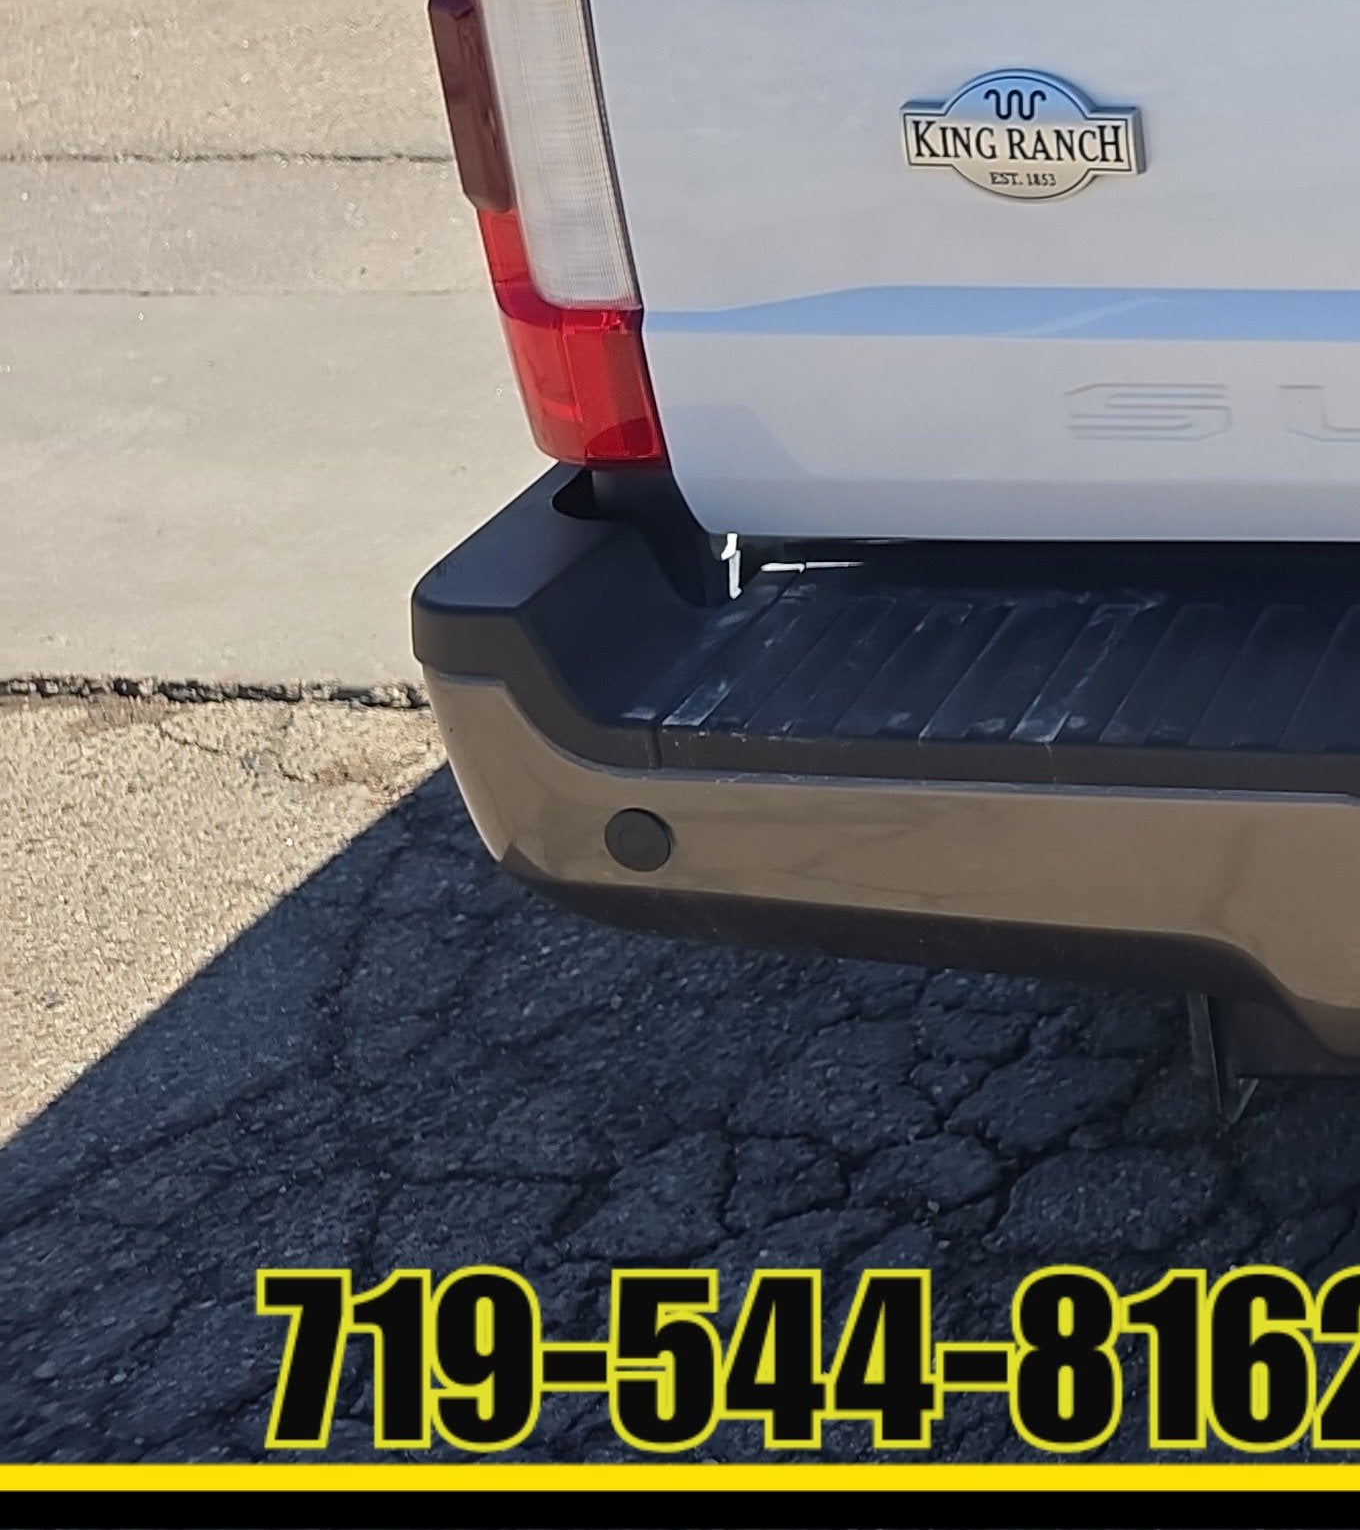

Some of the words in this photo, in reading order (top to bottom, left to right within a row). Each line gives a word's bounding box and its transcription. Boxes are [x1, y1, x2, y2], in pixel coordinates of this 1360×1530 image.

[910, 120, 998, 160] KING
[1007, 124, 1125, 163] RANCH
[989, 171, 1024, 186] EST.
[1025, 172, 1058, 187] 1853
